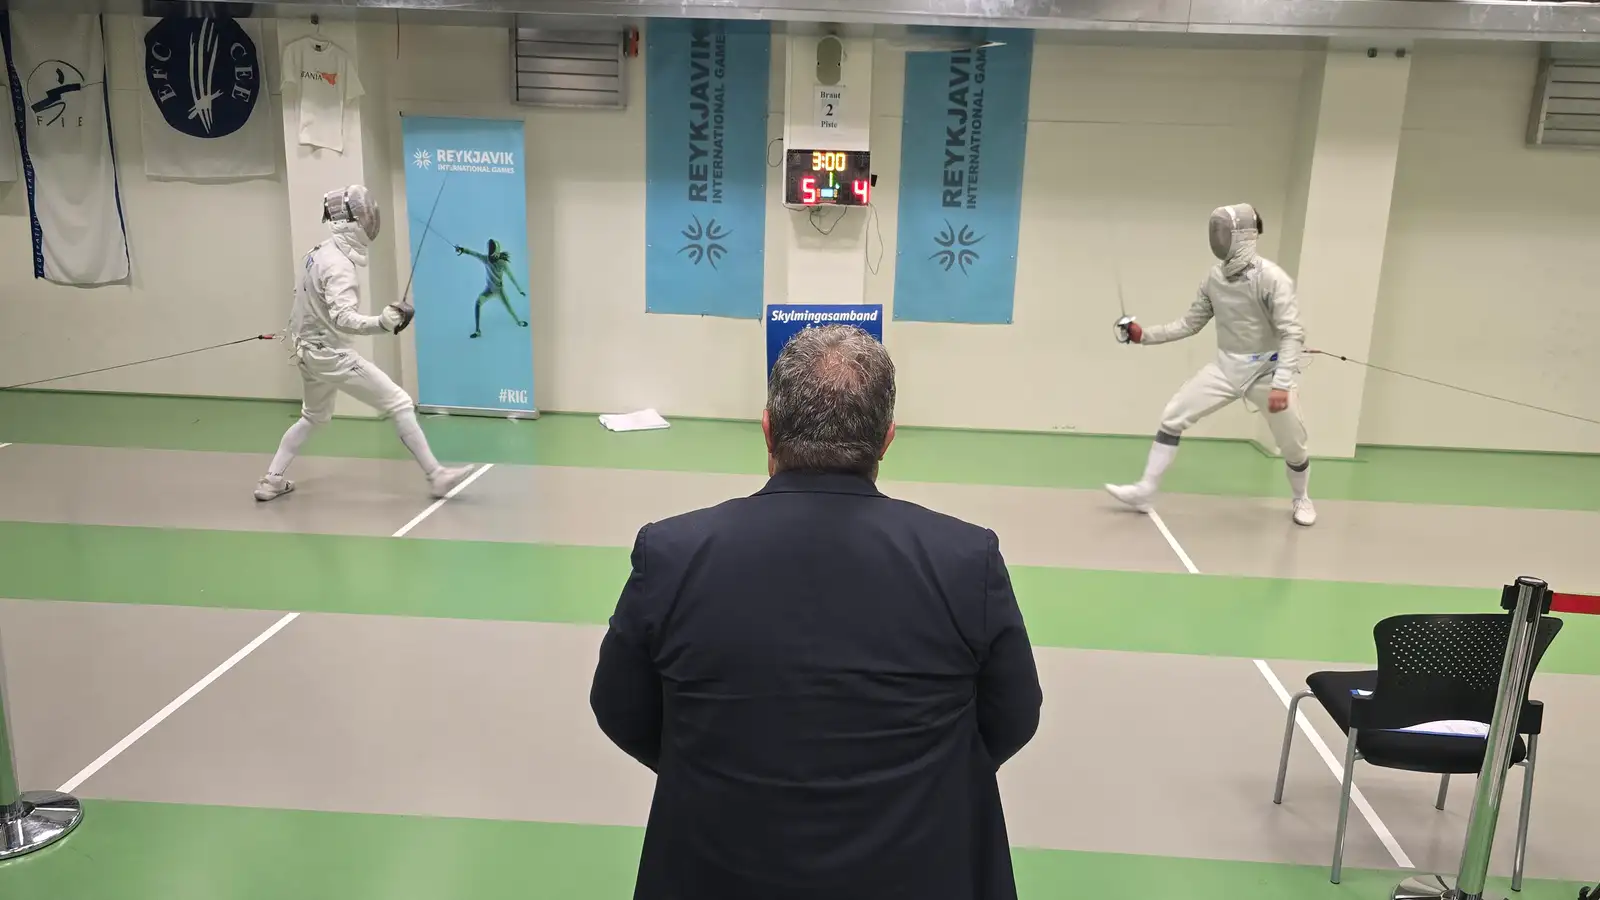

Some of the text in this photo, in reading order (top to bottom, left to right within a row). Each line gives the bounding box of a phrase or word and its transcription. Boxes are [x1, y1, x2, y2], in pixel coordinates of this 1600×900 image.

[151, 41, 177, 104] EFC
[230, 42, 254, 103] CEE
[820, 91, 841, 99] Braut
[689, 27, 711, 202] REYKJAVIK
[712, 32, 726, 204] INTERNATIONAL GAME
[825, 103, 834, 116] 2
[942, 48, 972, 208] REYKJAVI
[966, 48, 987, 209] INTERNATIONAL GAM
[436, 149, 514, 165] REYKJAVIK
[812, 151, 847, 172] 3:00
[491, 166, 515, 174] GAMES
[802, 177, 816, 203] 5
[854, 179, 869, 204] 4
[771, 309, 878, 323] Skylmingasamband
[498, 388, 528, 404] #RIG
